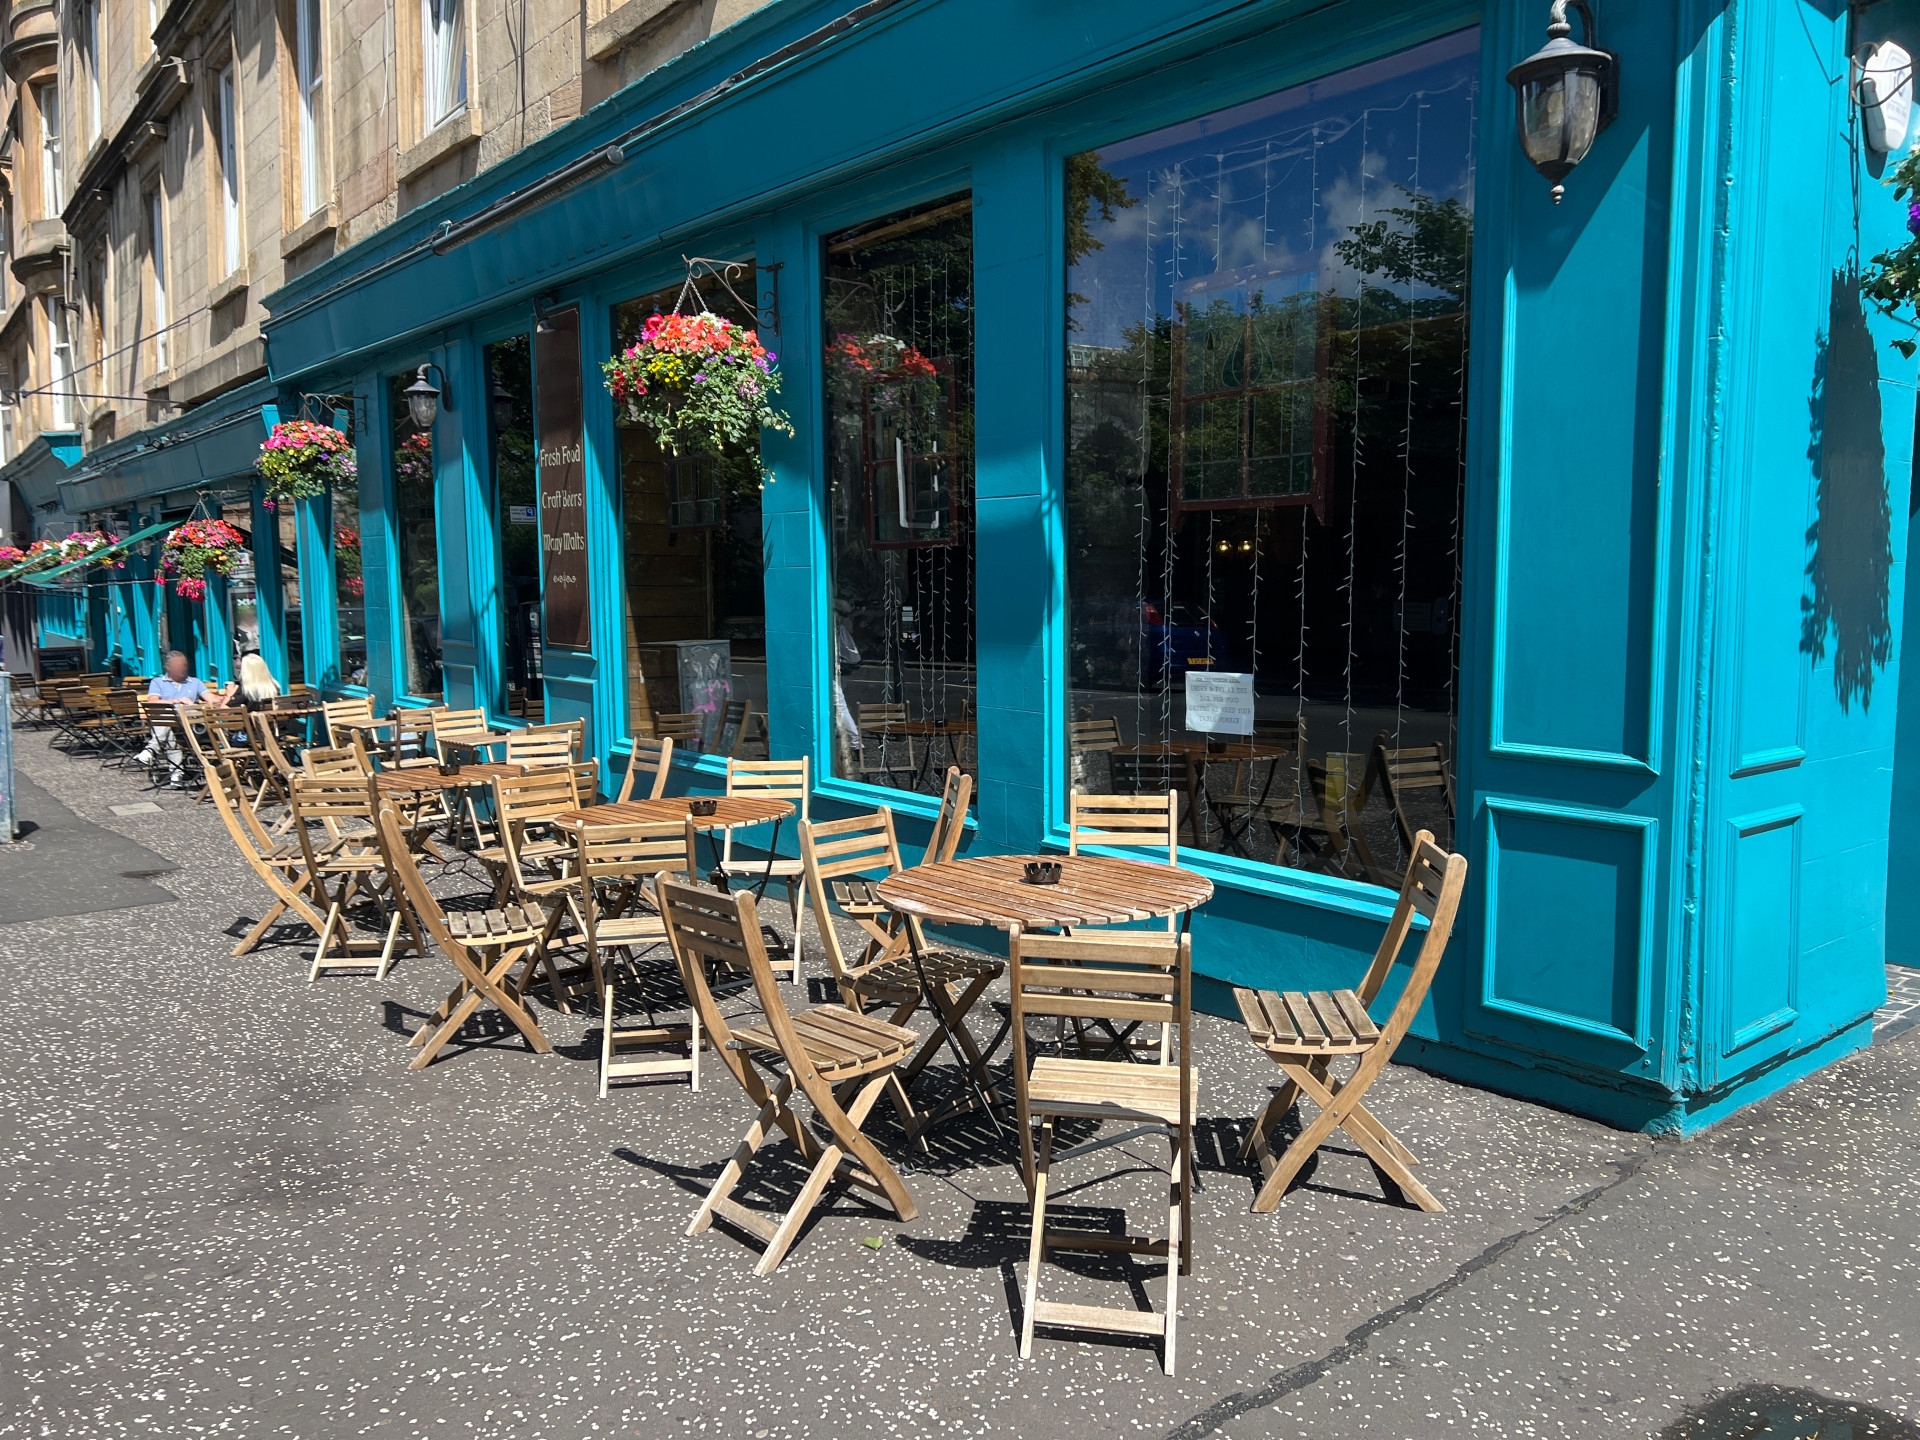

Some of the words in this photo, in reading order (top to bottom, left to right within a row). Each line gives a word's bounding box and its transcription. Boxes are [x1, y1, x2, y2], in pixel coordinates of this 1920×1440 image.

[540, 448, 561, 468] Fresh
[562, 444, 581, 465] Food
[541, 490, 562, 509] Craft
[562, 489, 583, 508] Beers
[543, 533, 563, 555] Many
[562, 531, 585, 551] Malts
